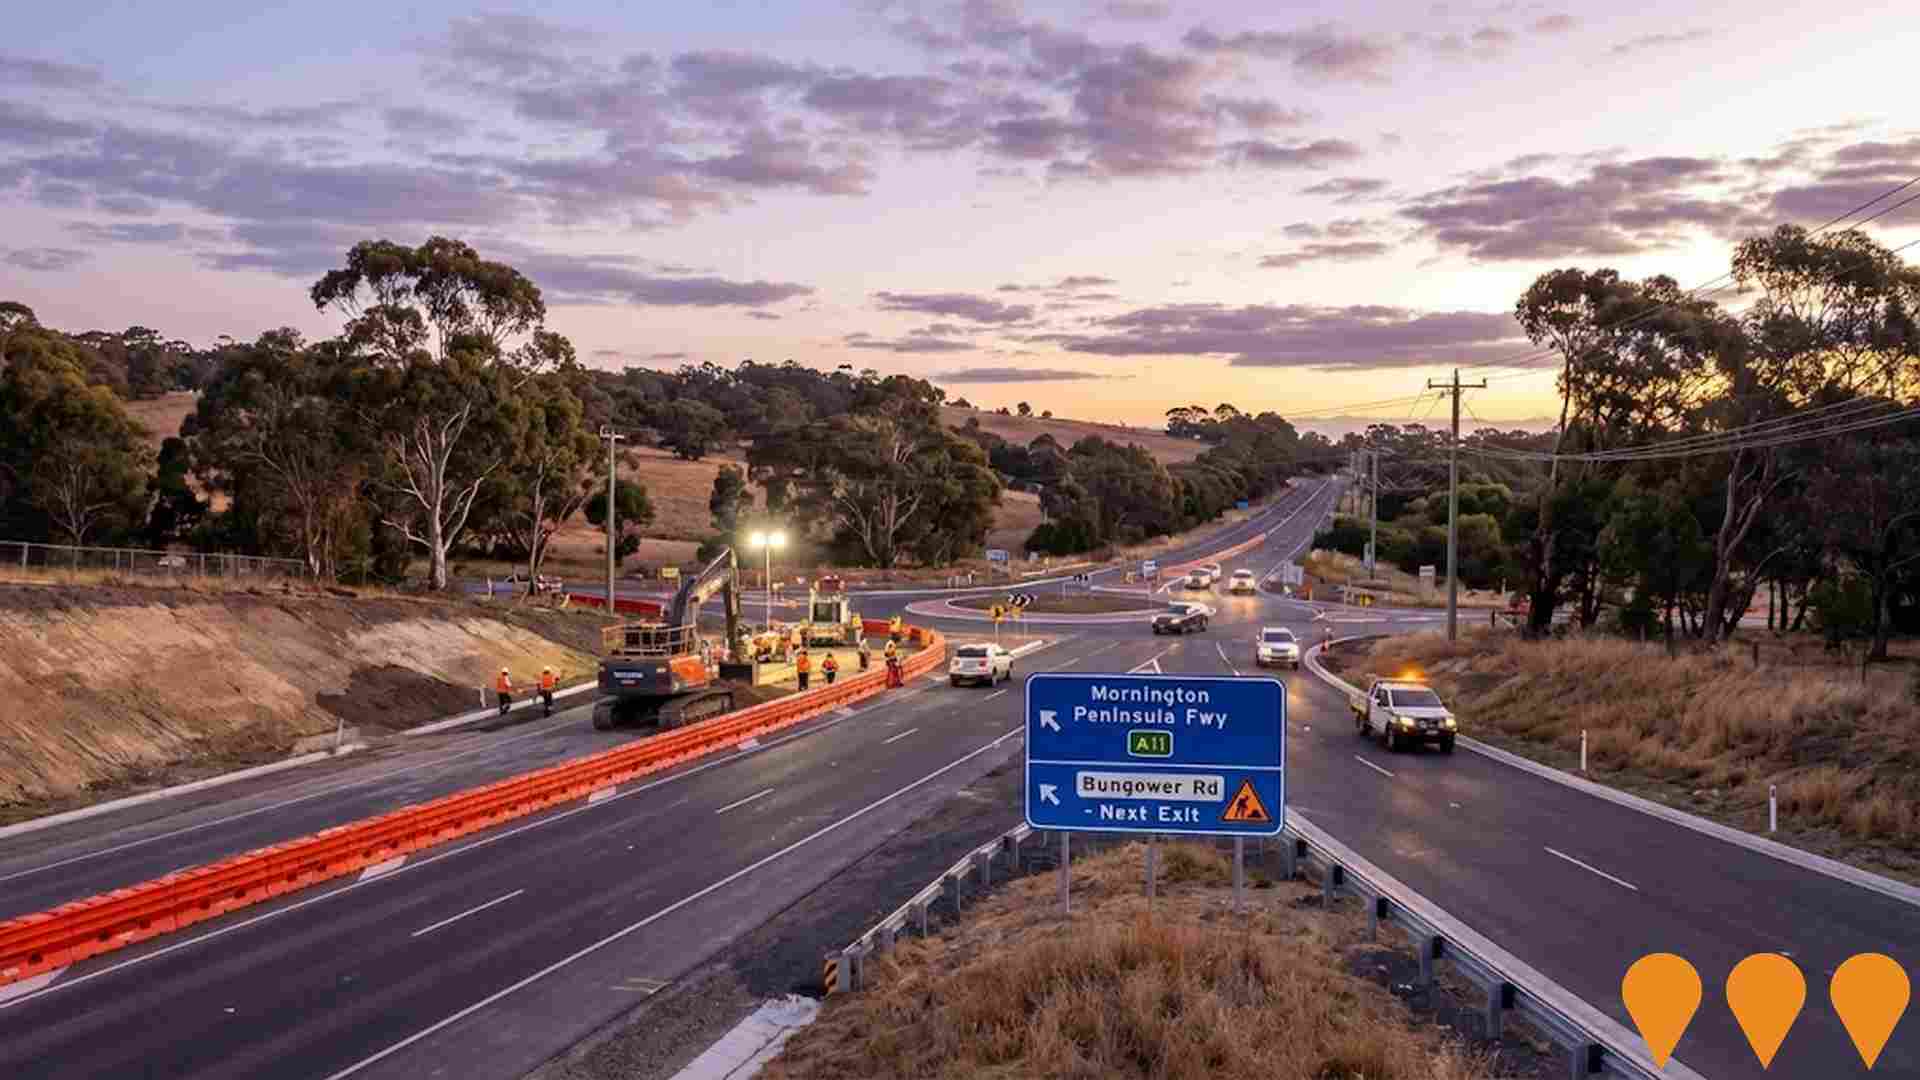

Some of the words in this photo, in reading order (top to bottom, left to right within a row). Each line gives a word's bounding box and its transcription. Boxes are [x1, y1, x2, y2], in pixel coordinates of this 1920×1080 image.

[1091, 685, 1209, 707] Mornington
[1074, 706, 1175, 724] Peninsula
[1186, 708, 1227, 730] Fwy
[1136, 737, 1165, 751] A11
[1082, 776, 1182, 796] Bungower
[1193, 779, 1218, 796] Rd
[1100, 804, 1147, 821] Next
[1158, 805, 1200, 822] Exit
